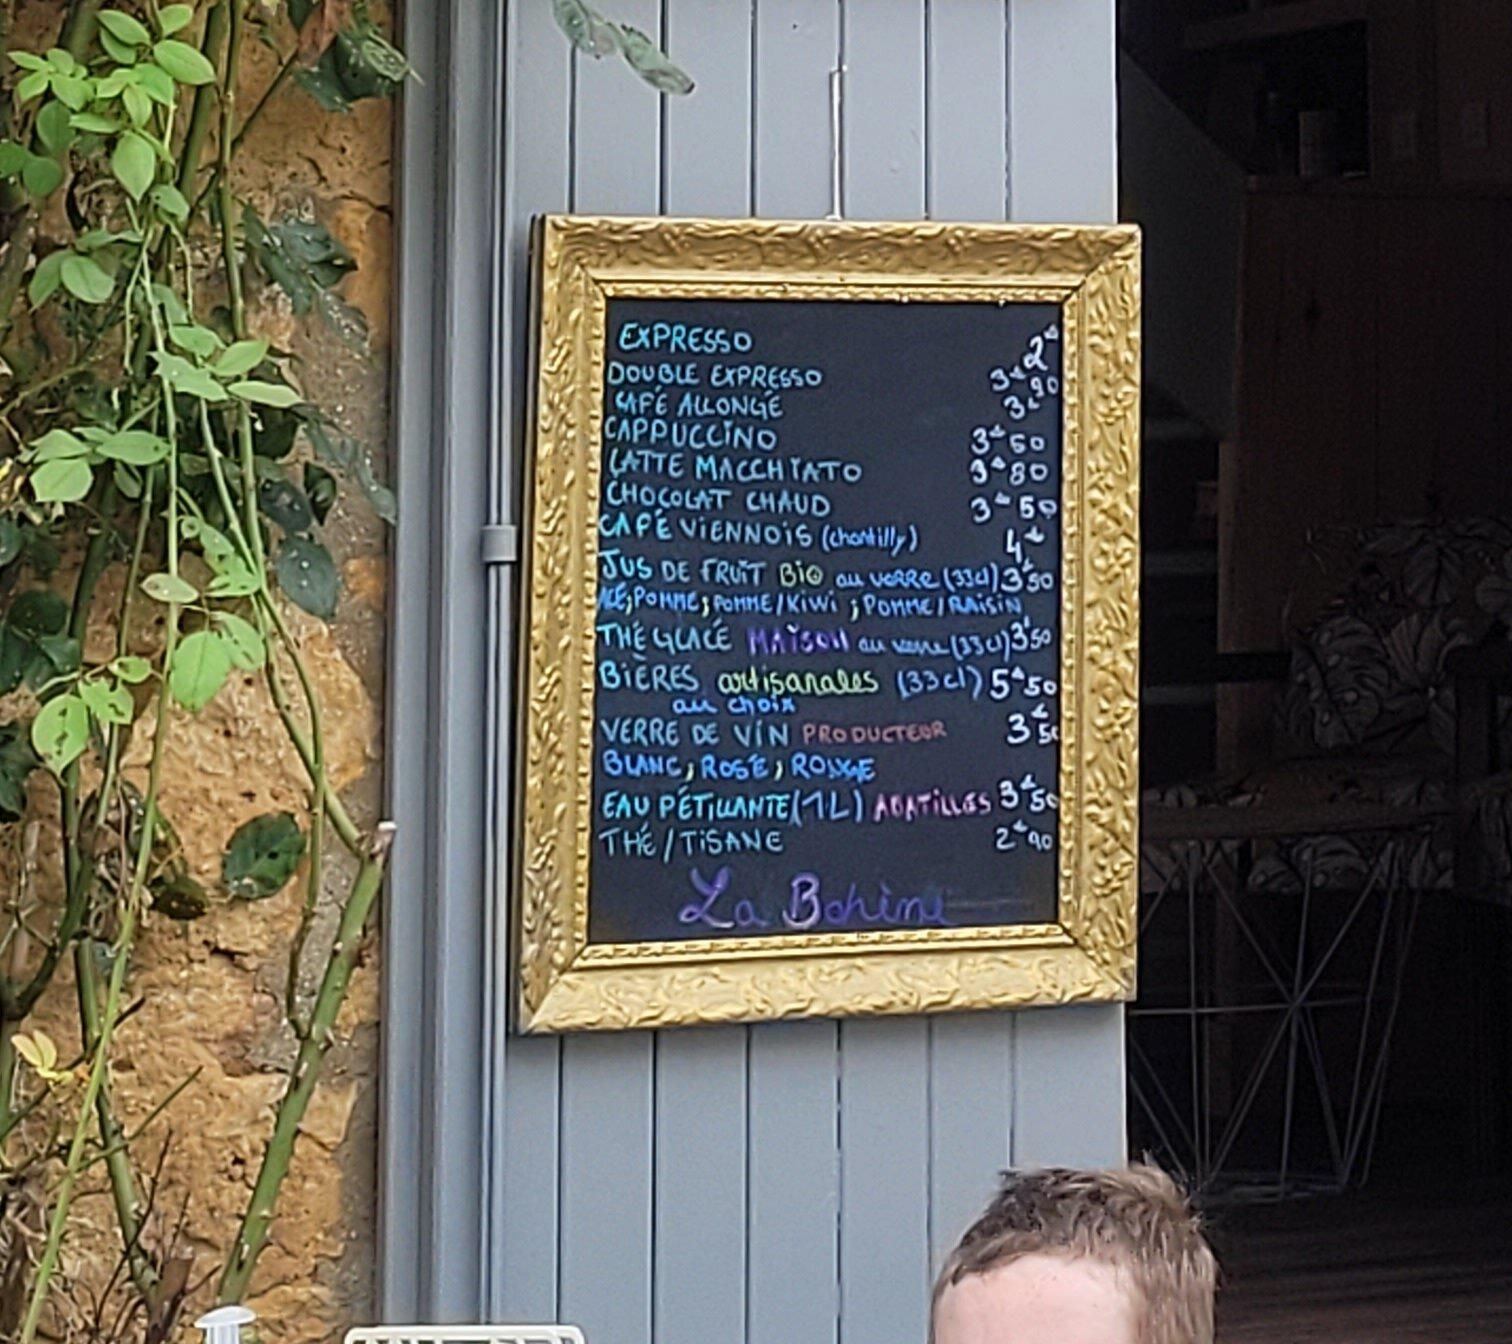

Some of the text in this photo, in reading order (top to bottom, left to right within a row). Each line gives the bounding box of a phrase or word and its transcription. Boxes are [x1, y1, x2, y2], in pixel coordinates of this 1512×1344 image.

[619, 322, 752, 354] EXPRESSO
[607, 361, 700, 386] DOUBLE
[710, 364, 823, 389] EXPRESSO
[615, 384, 668, 415] CAFÉ
[677, 389, 784, 420] ALLONGÉ
[609, 448, 684, 478] LATTE
[606, 480, 733, 511] CHOCOLAT
[746, 490, 831, 517] CHAUD
[599, 508, 672, 540] CAFÉ
[597, 548, 653, 580] JUS
[661, 561, 690, 583] DE
[597, 620, 646, 651] THÉ
[672, 693, 796, 716] au choix
[600, 717, 680, 747] VERRE
[691, 722, 720, 746] DE
[802, 720, 948, 745] PRODUCTEUR
[602, 790, 650, 819] EAU
